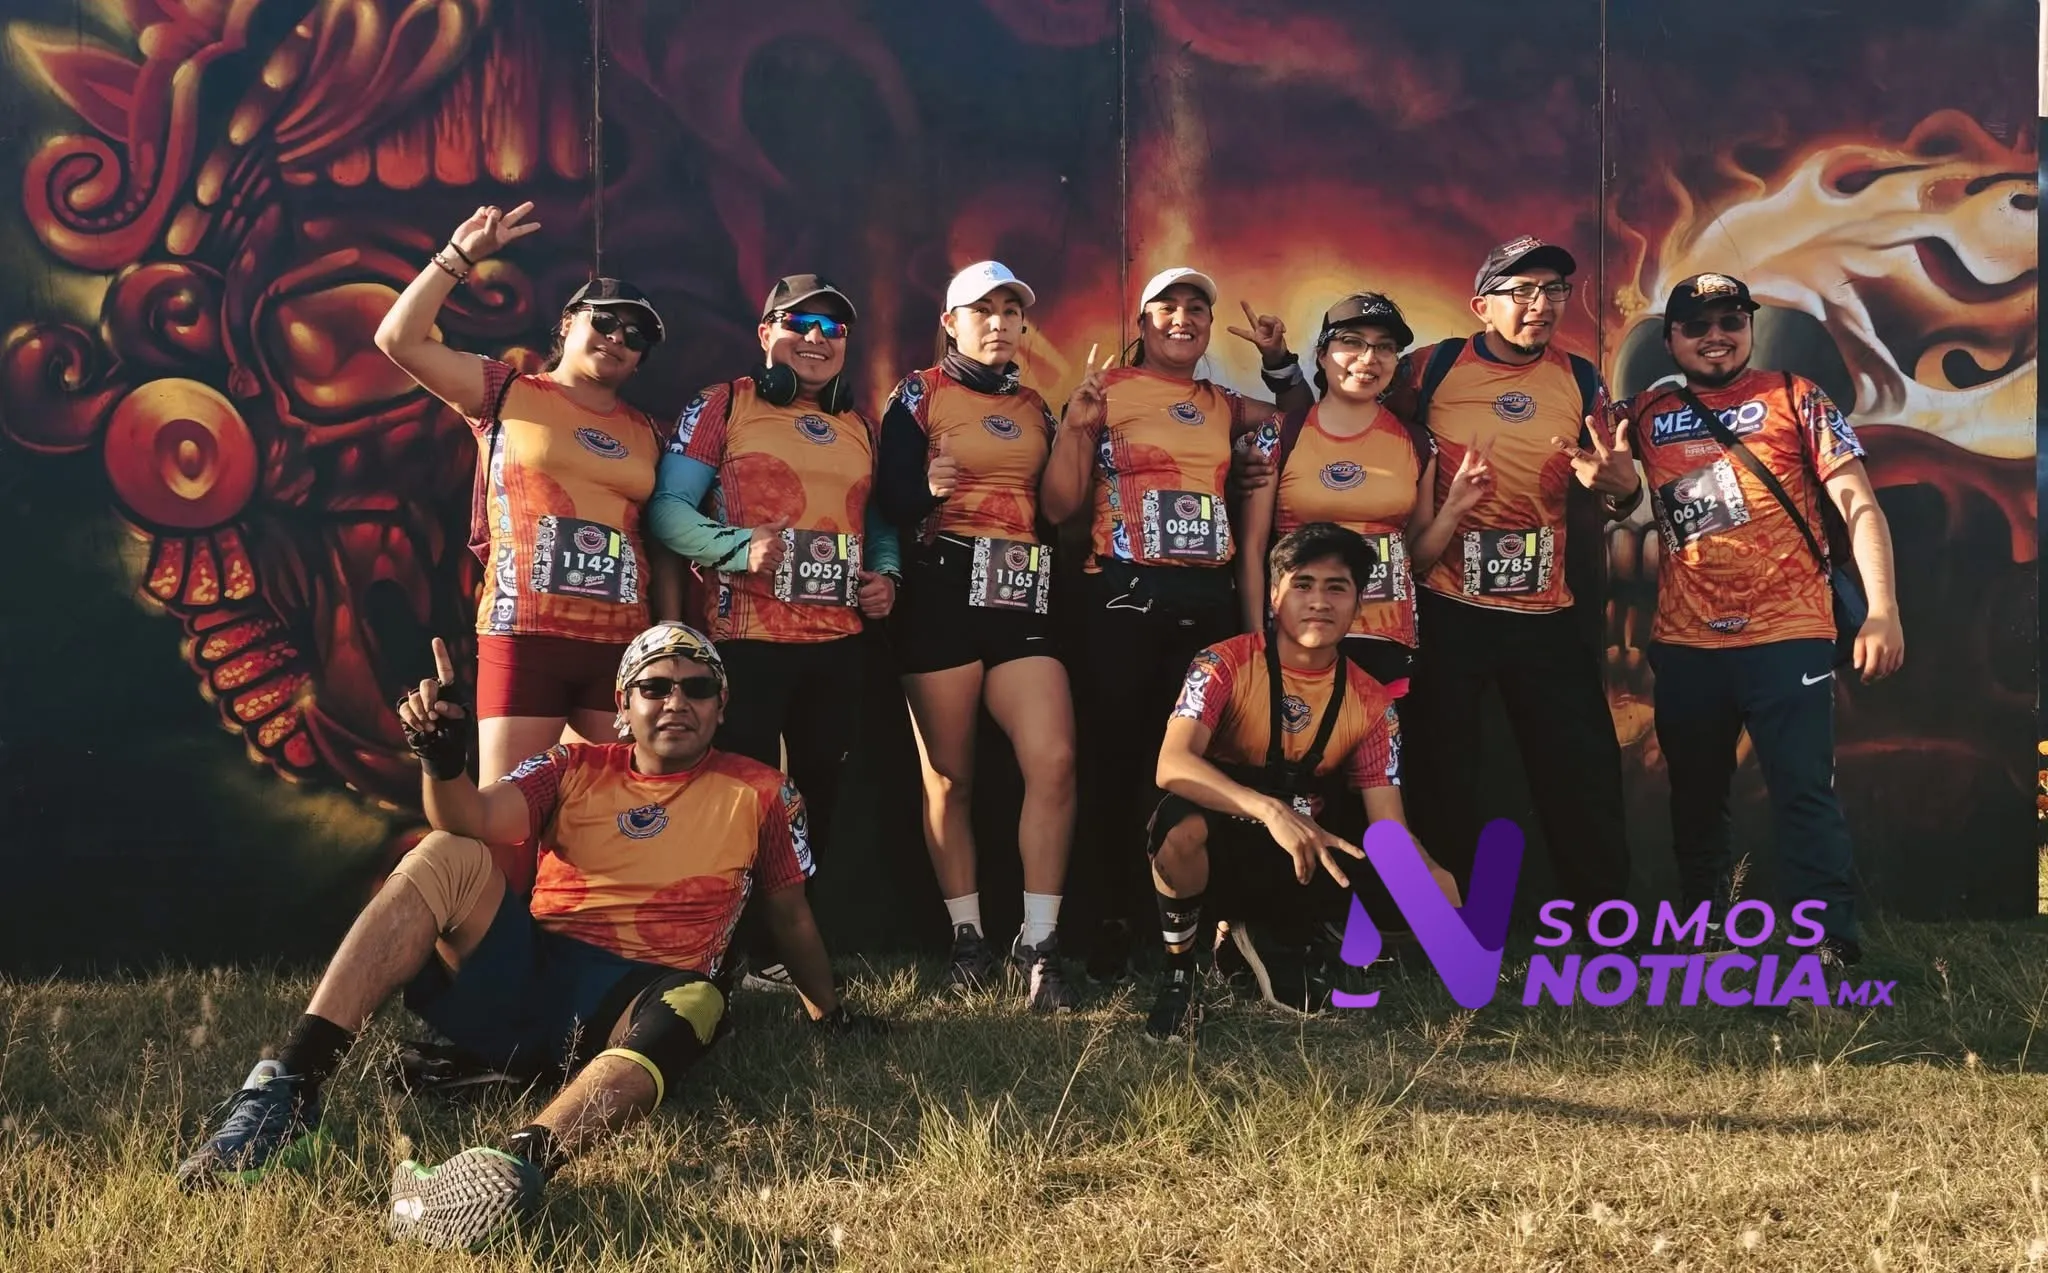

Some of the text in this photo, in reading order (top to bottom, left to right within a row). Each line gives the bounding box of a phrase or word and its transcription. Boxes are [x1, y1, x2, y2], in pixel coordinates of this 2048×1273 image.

[1497, 395, 1532, 403] VIRTUS
[1653, 402, 1765, 437] MÉCO
[1326, 463, 1362, 472] VIRTUS
[1673, 495, 1719, 525] 0612
[1165, 519, 1210, 536] 0848
[563, 551, 615, 574] 1142
[799, 561, 843, 580] 0952
[1369, 563, 1388, 579] 23
[1487, 557, 1533, 574] 0785
[996, 568, 1033, 588] 1165
